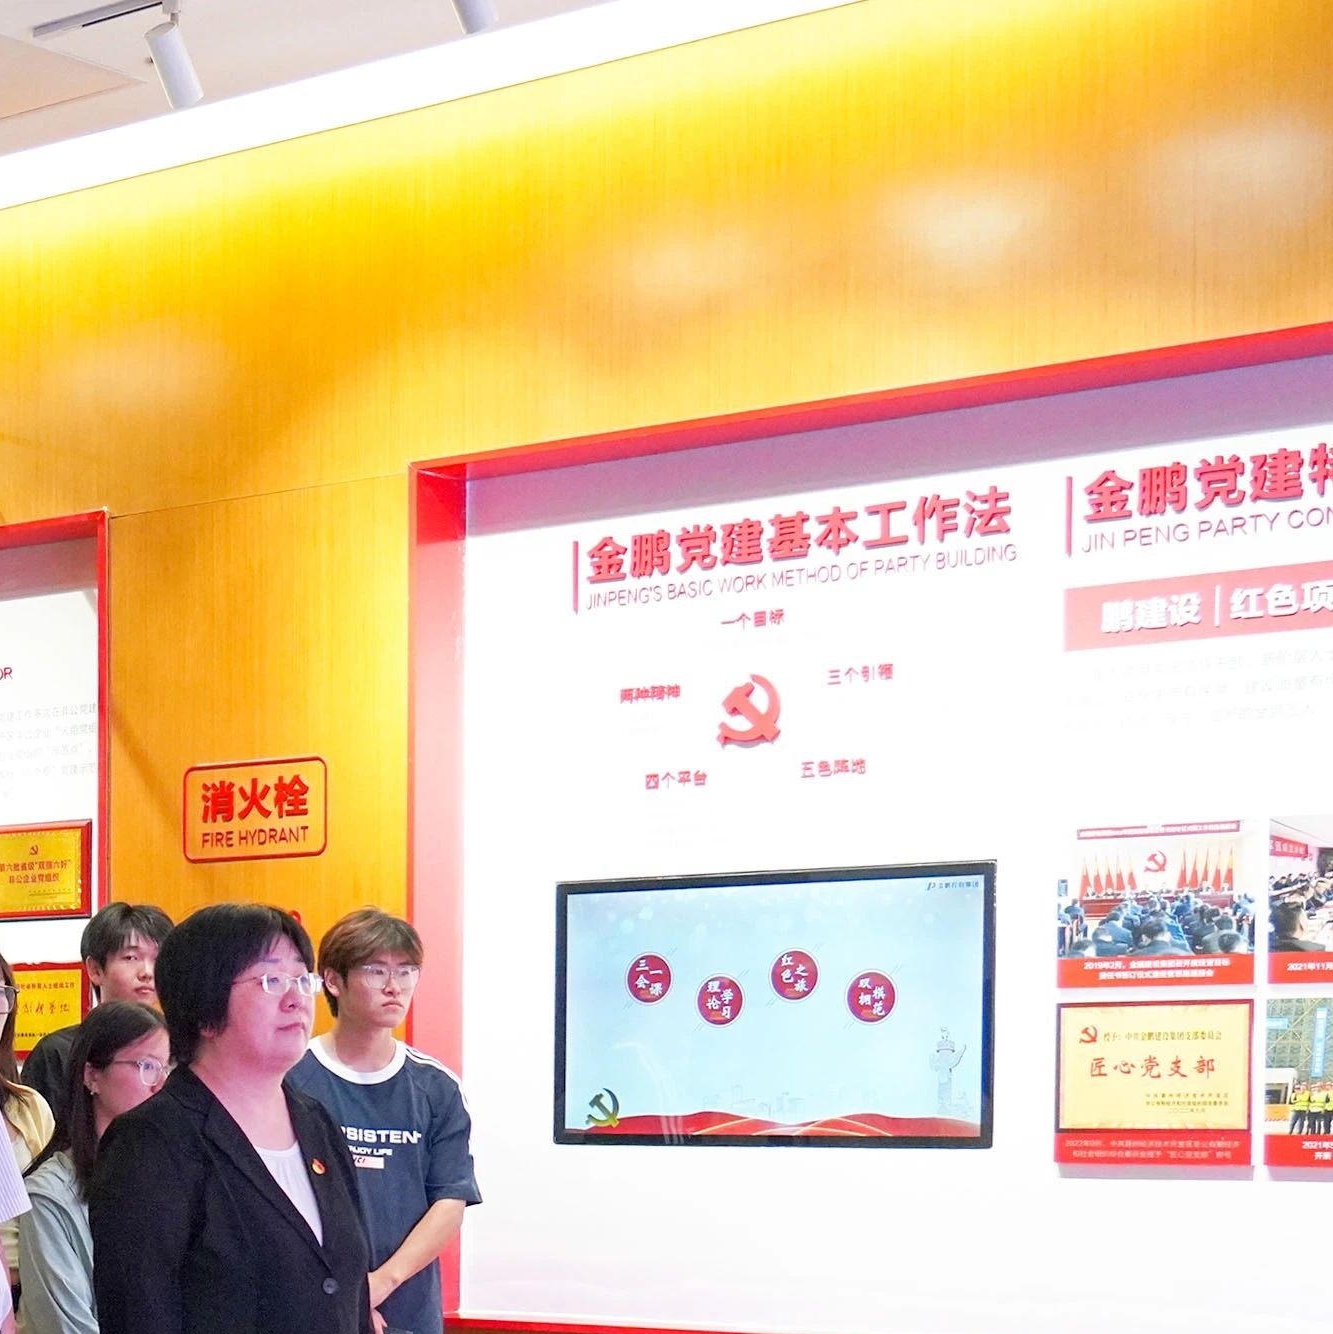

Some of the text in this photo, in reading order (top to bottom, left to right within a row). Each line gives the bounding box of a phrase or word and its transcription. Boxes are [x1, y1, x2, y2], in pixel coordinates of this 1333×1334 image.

[587, 485, 1012, 584] 金鹏党建基本工作法
[1082, 532, 1115, 553] JIN
[1123, 523, 1190, 547] PENG
[1198, 512, 1280, 539] PARTY
[586, 543, 1018, 611] JINPENG'S BASIC WORK METHOD OF PARTY BUILDING
[720, 609, 785, 630] 一个目标
[1101, 592, 1202, 634] 鹏建设
[201, 774, 310, 824] 消火栓
[201, 825, 310, 848] FIRE HYDRANT
[1089, 1055, 1215, 1080] 匠心党支部
[340, 1126, 422, 1144] SISTEN
